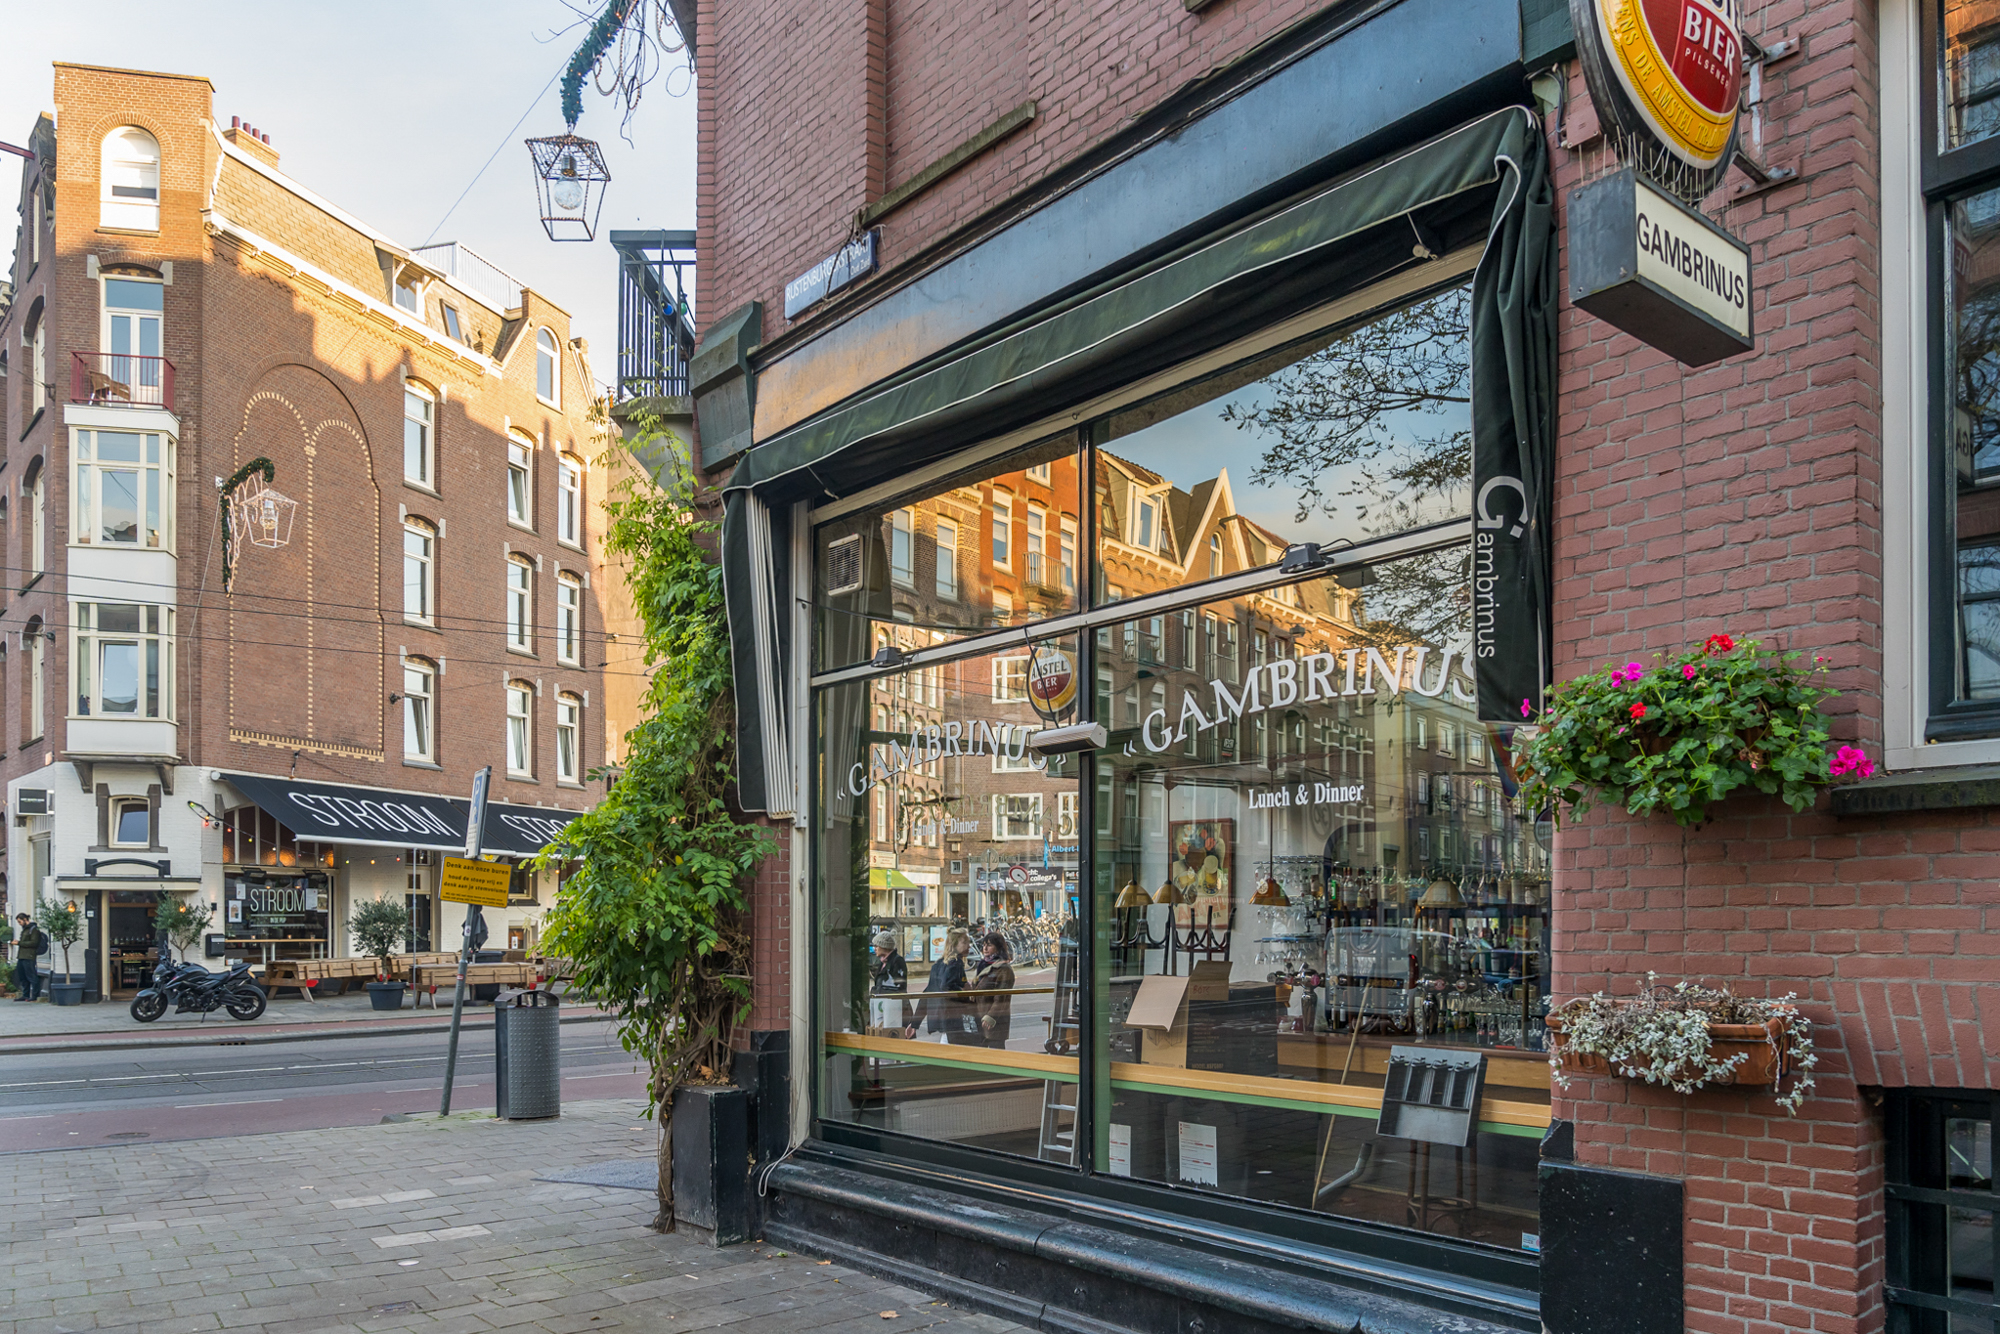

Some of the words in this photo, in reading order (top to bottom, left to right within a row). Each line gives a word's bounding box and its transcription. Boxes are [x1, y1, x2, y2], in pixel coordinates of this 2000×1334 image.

[1684, 6, 1735, 76] BIER
[1633, 50, 1655, 82] DE
[1651, 81, 1694, 136] AMSTEL
[1637, 212, 1745, 309] GAMBRINUS
[1476, 475, 1528, 659] Gambrinus
[1037, 676, 1057, 690] BER
[1248, 786, 1290, 809] Lunch
[1295, 784, 1309, 806] &
[1314, 781, 1364, 804] Dinner
[288, 791, 461, 838] STROOM
[912, 819, 936, 837] Lunch
[950, 818, 979, 835] Dinner
[446, 861, 461, 869] Denk
[250, 888, 305, 912] STROOM
